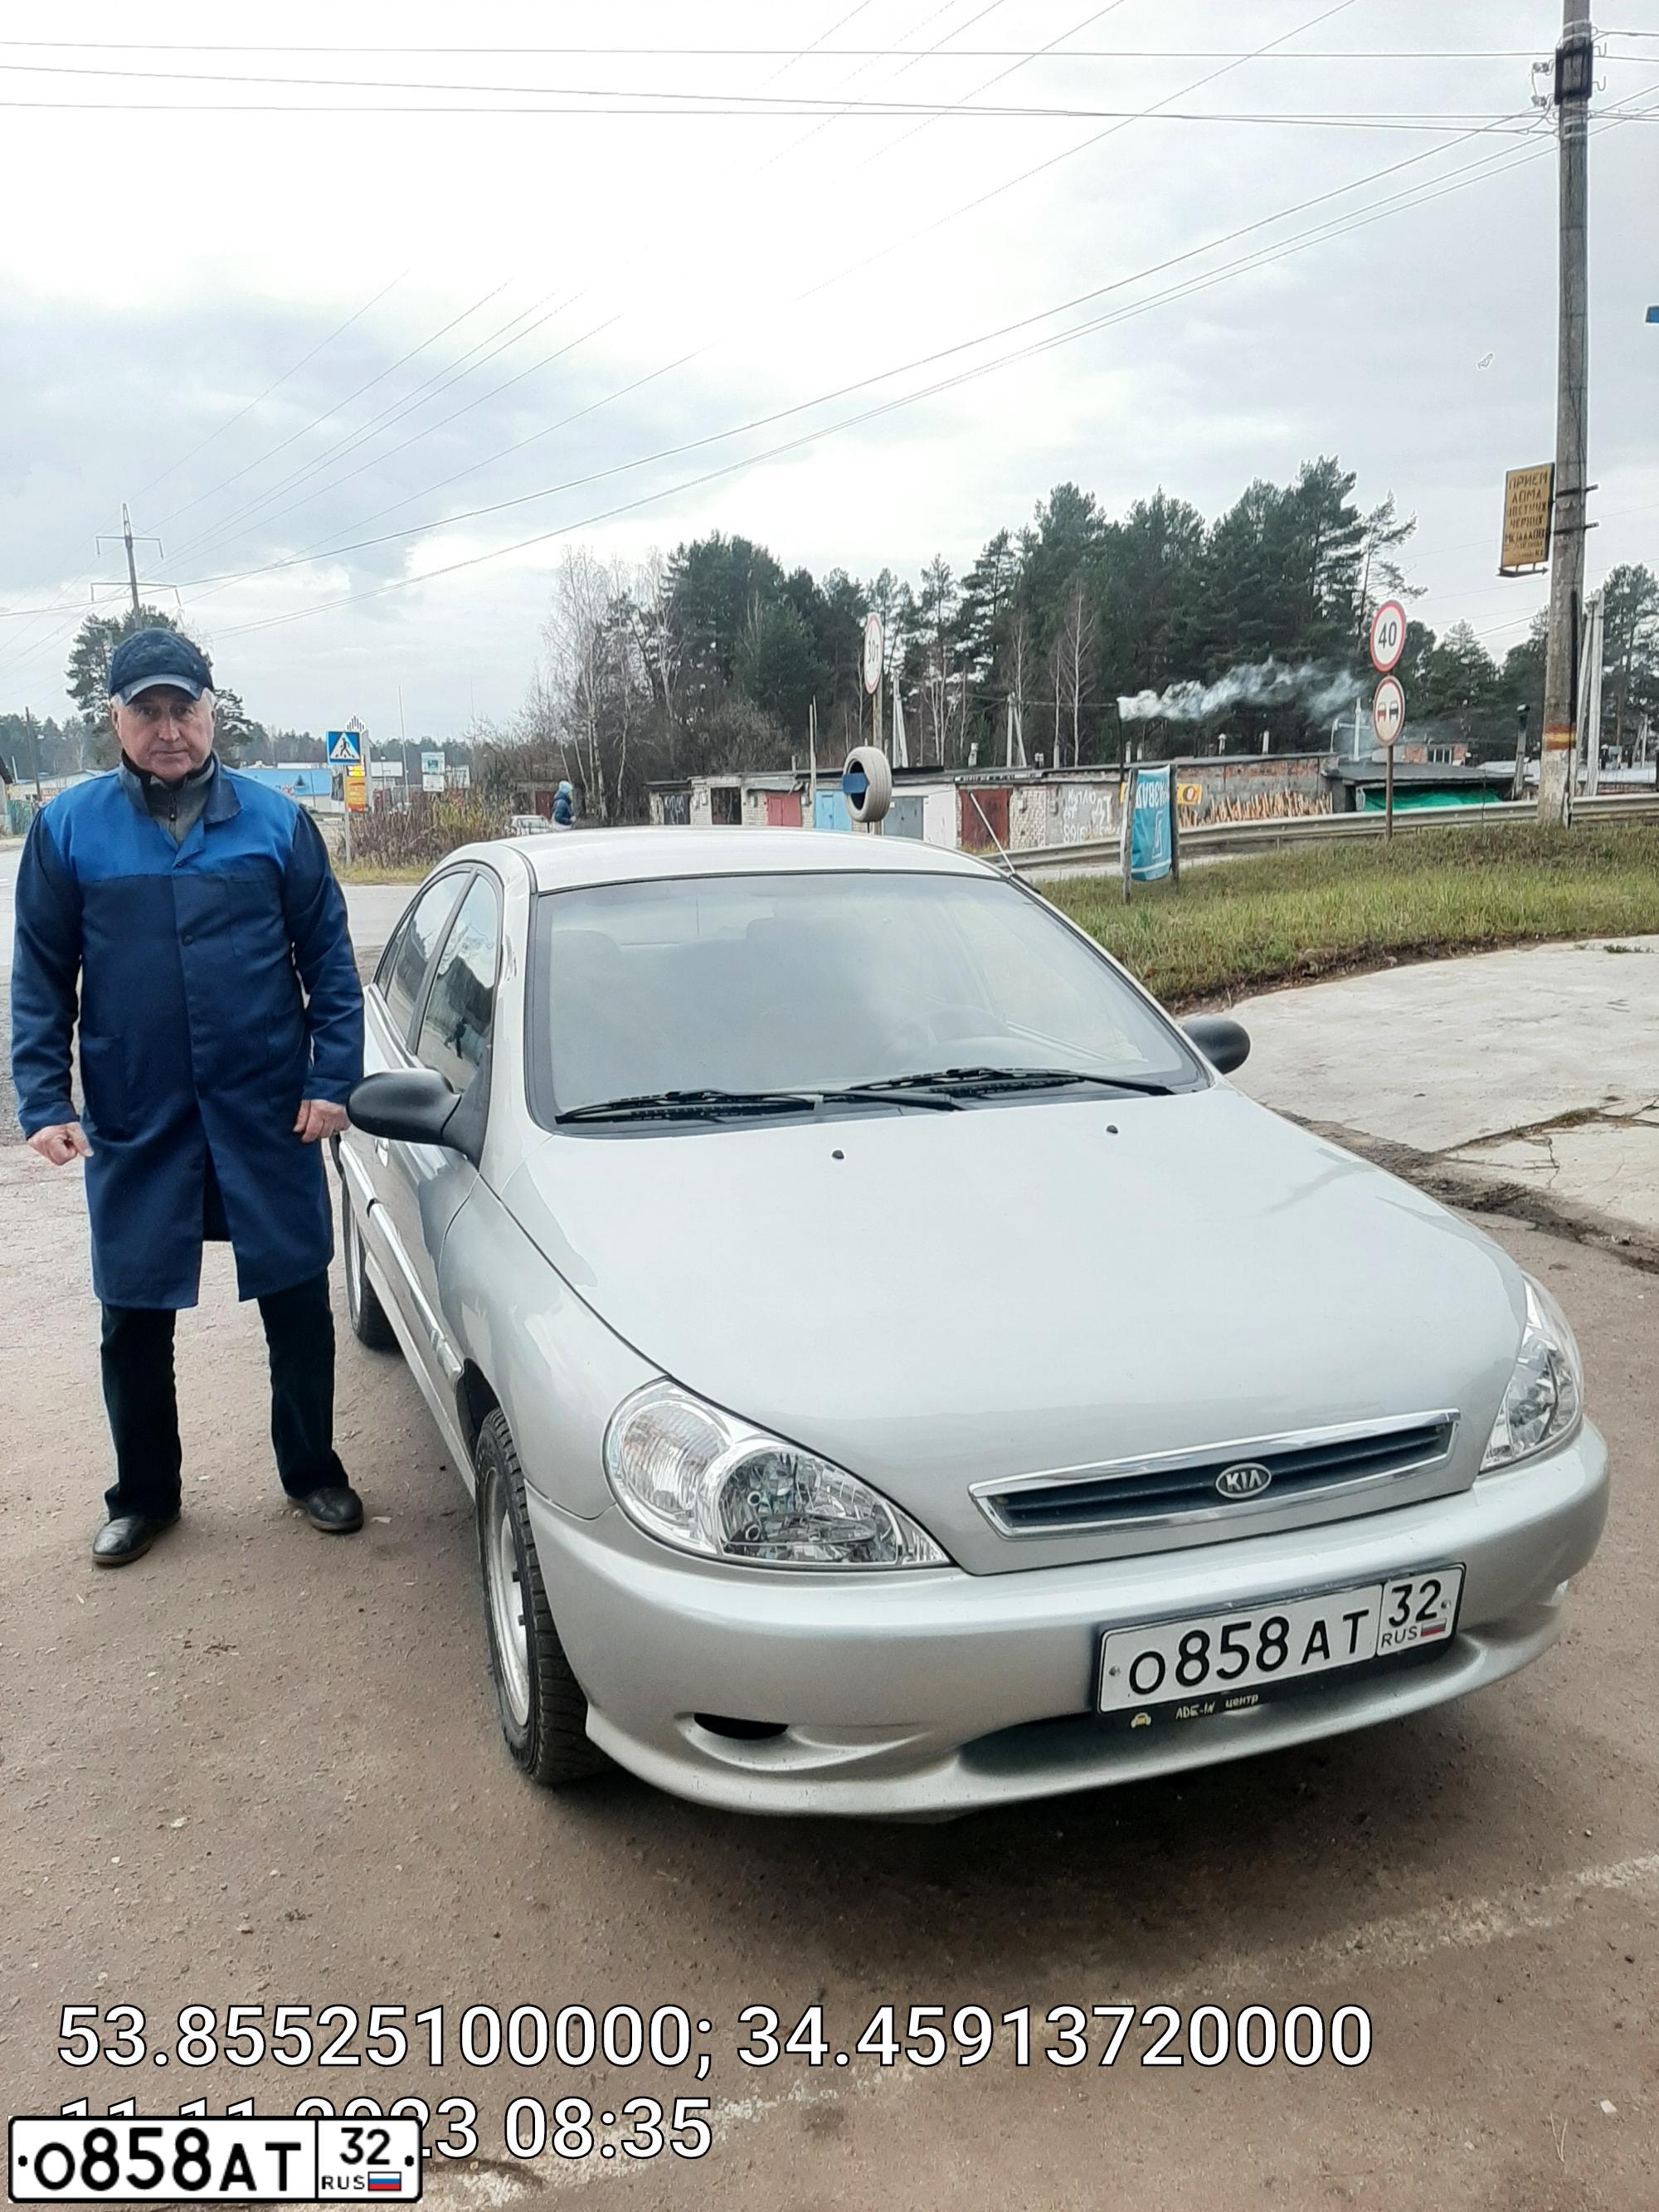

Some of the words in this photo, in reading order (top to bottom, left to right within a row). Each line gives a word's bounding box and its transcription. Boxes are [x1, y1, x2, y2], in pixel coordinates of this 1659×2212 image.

[1509, 470, 1548, 490] ПРИЕМ
[1378, 621, 1397, 649] 40
[1225, 1469, 1262, 1492] KIA
[1388, 1579, 1442, 1628] 32
[1380, 1625, 1418, 1649] RUS
